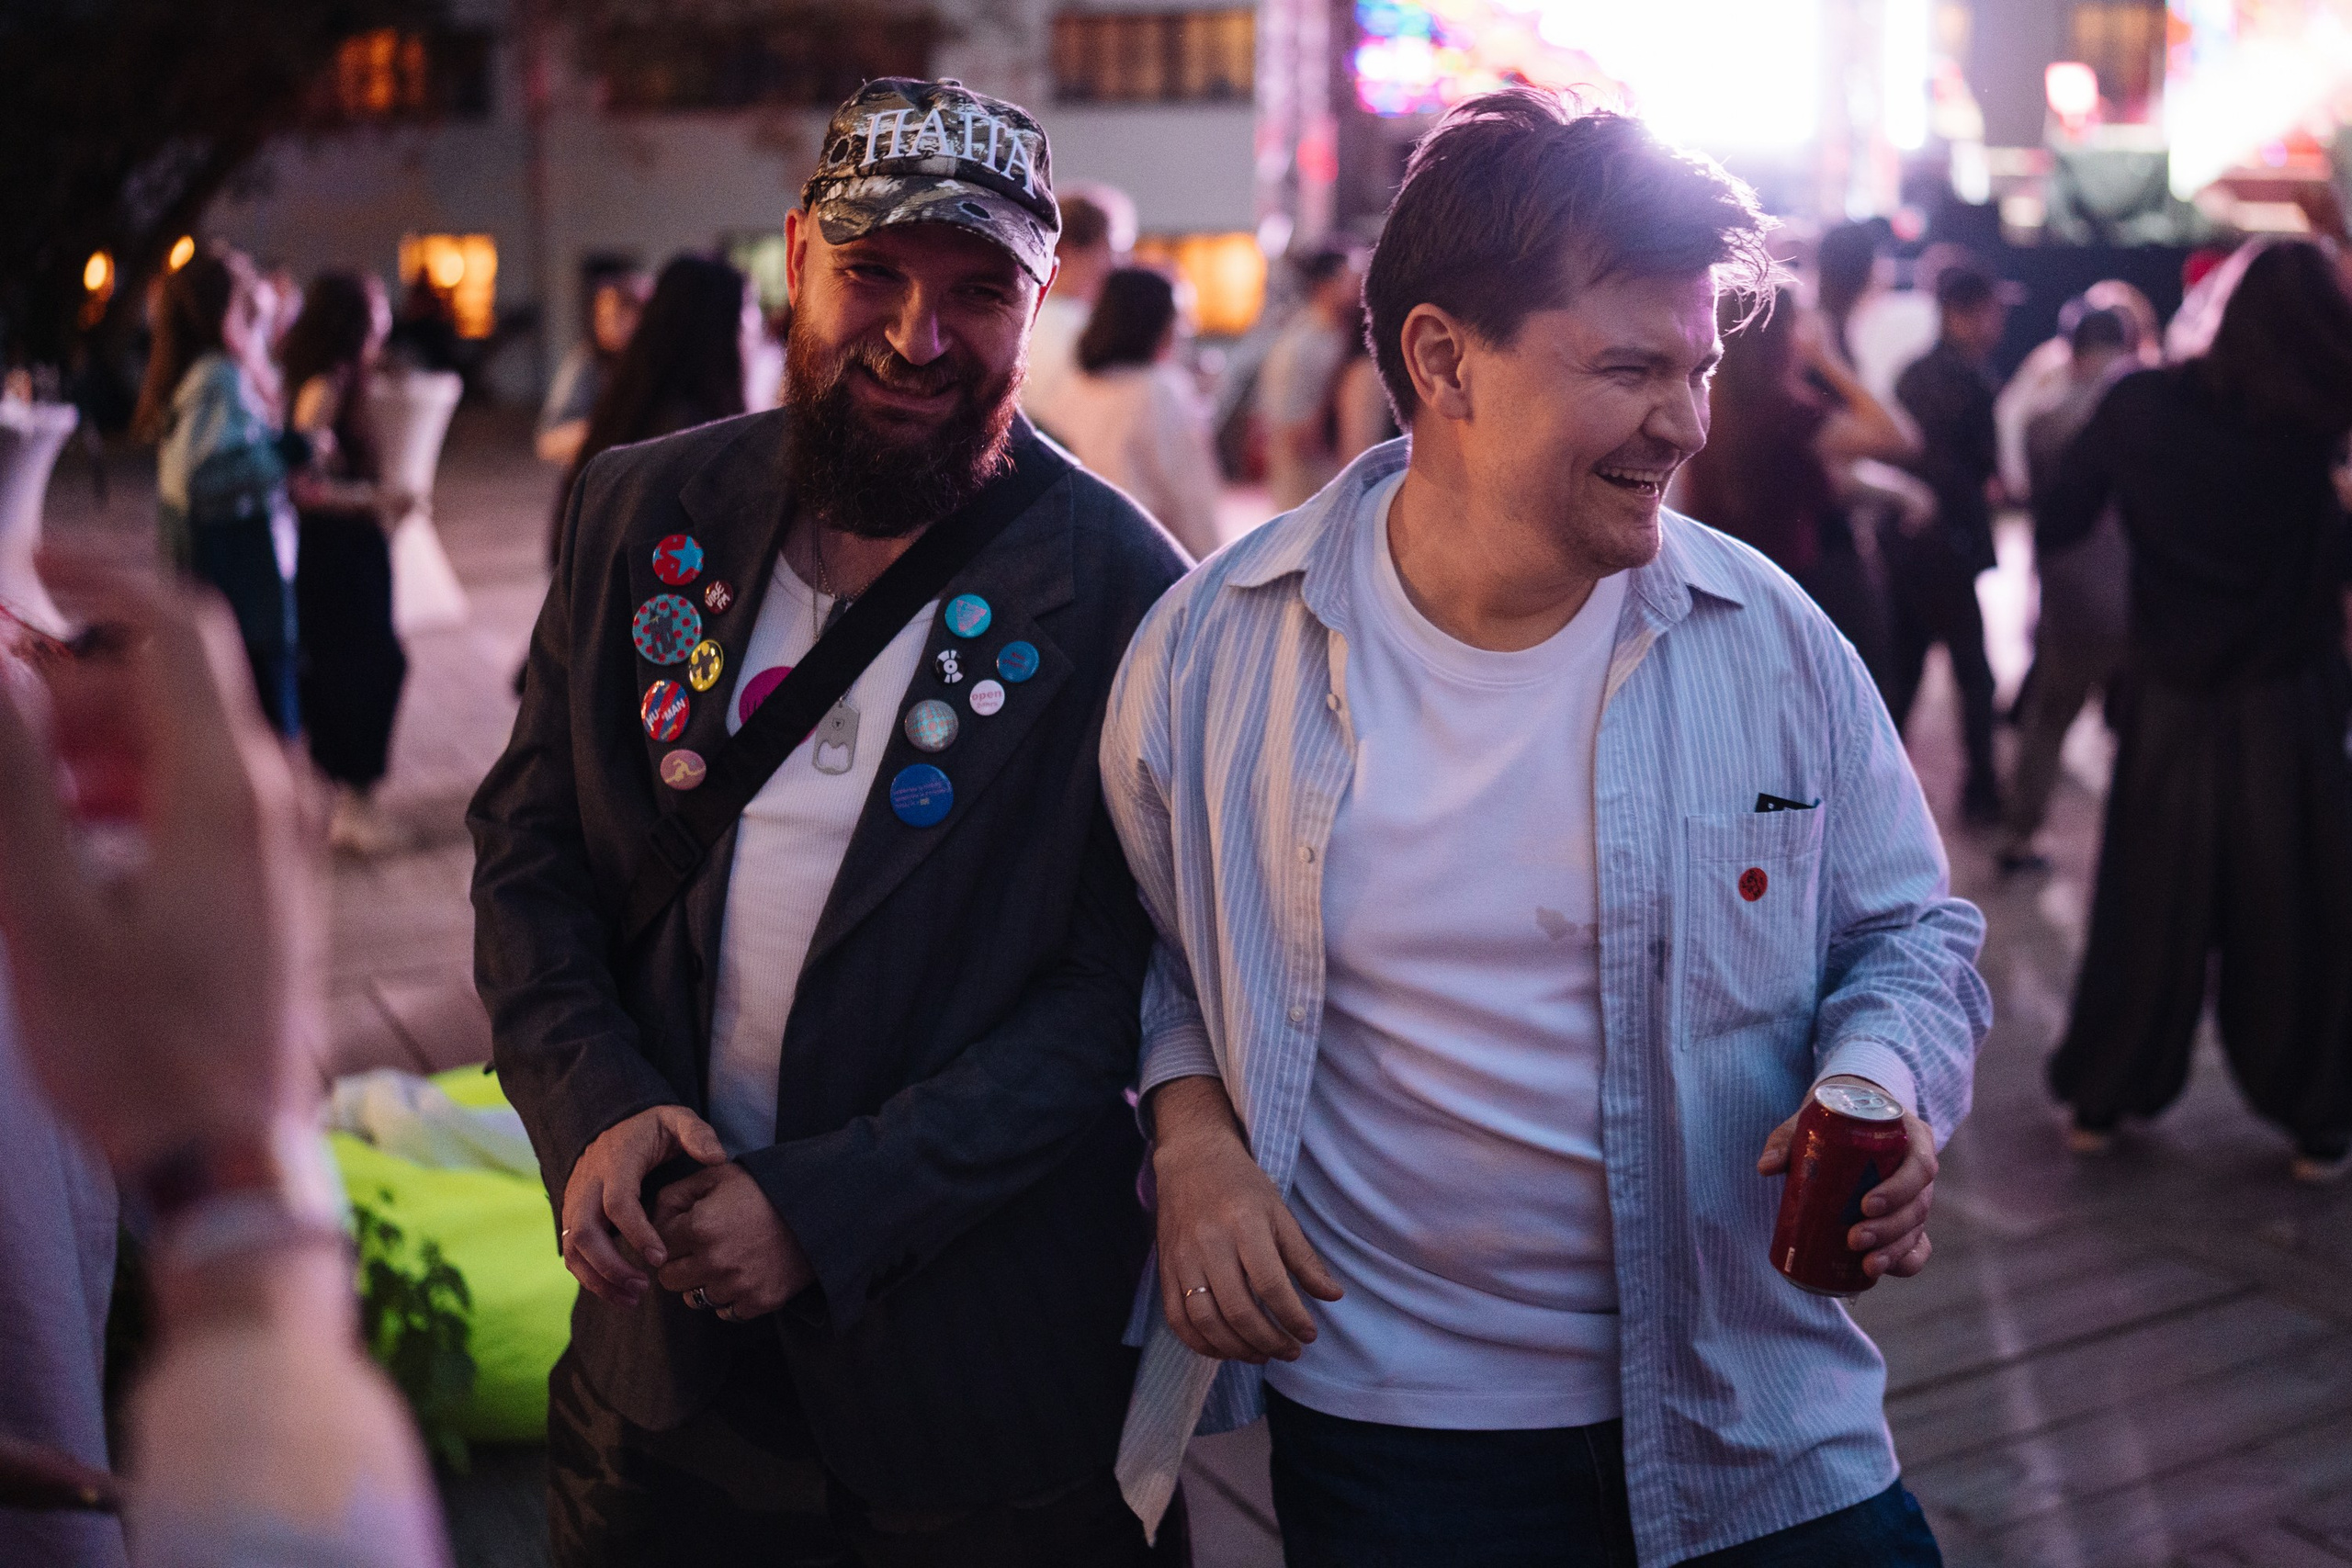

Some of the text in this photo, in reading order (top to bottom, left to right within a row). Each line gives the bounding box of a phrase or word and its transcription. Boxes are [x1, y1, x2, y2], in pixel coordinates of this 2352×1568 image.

[859, 107, 1036, 199] ПАПА
[705, 581, 725, 607] VIBE
[717, 592, 731, 610] FM
[971, 690, 1002, 702] open
